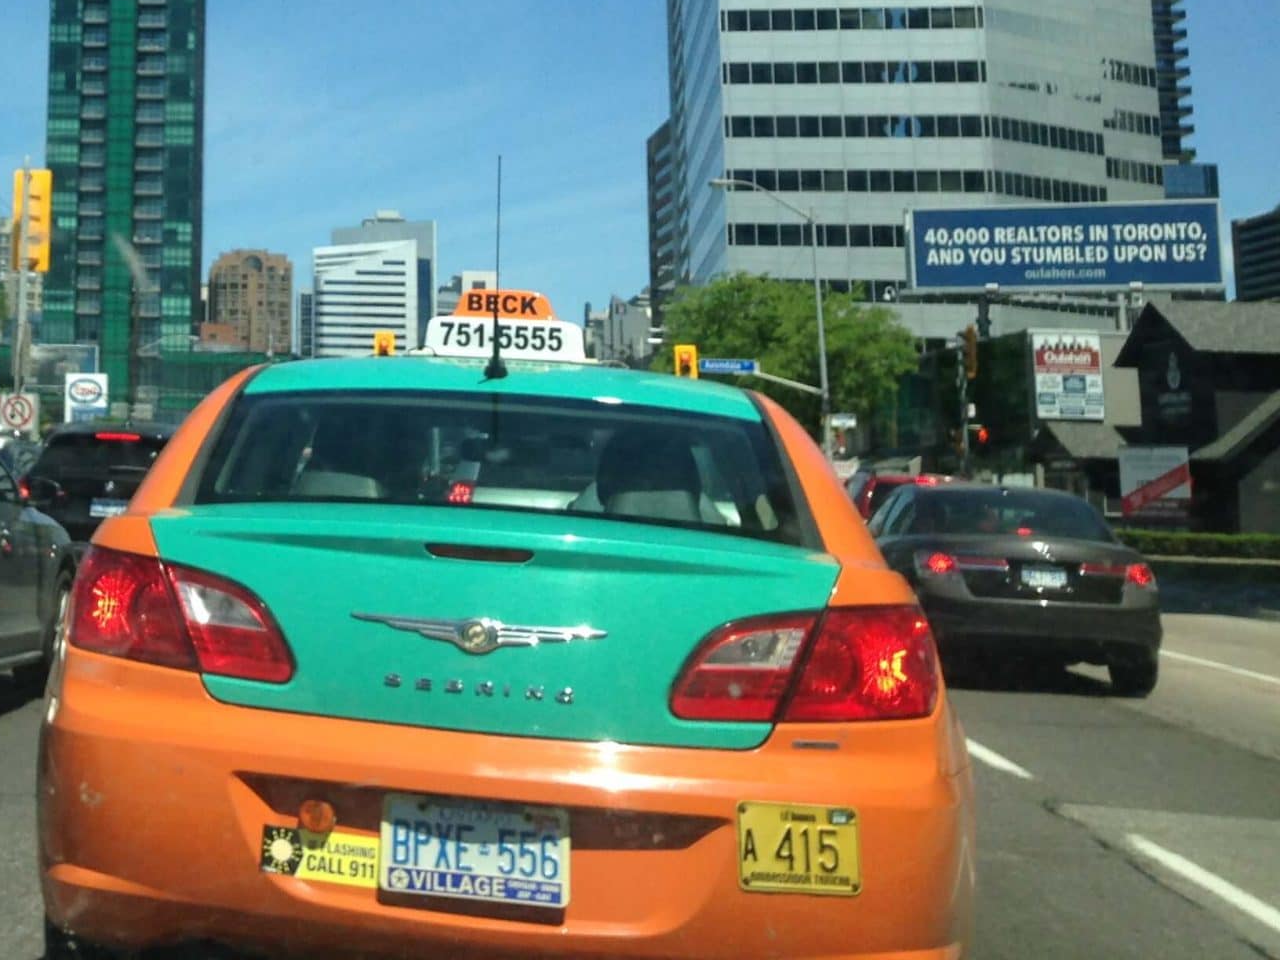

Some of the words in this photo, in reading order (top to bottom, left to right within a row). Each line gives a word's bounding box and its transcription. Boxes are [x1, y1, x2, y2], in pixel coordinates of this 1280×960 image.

[924, 227, 989, 247] 40,000
[994, 225, 1085, 244] REALTORS
[1089, 225, 1108, 242] IN
[1112, 222, 1207, 242] TORONTO,
[926, 248, 965, 266] AND
[969, 247, 1006, 264] YOU
[1011, 245, 1109, 263] STUMBLED
[1114, 244, 1167, 262] UPON
[1172, 243, 1208, 261] US?
[467, 293, 537, 315] BECK
[439, 322, 563, 352] 751-5555
[383, 672, 574, 705] SEBRING
[392, 820, 473, 872] BPXE
[497, 828, 559, 879] 556
[743, 828, 757, 861] A
[775, 827, 839, 873] 415
[307, 854, 345, 875] CALL
[349, 860, 374, 879] 911
[411, 872, 506, 897] VILLAGE
